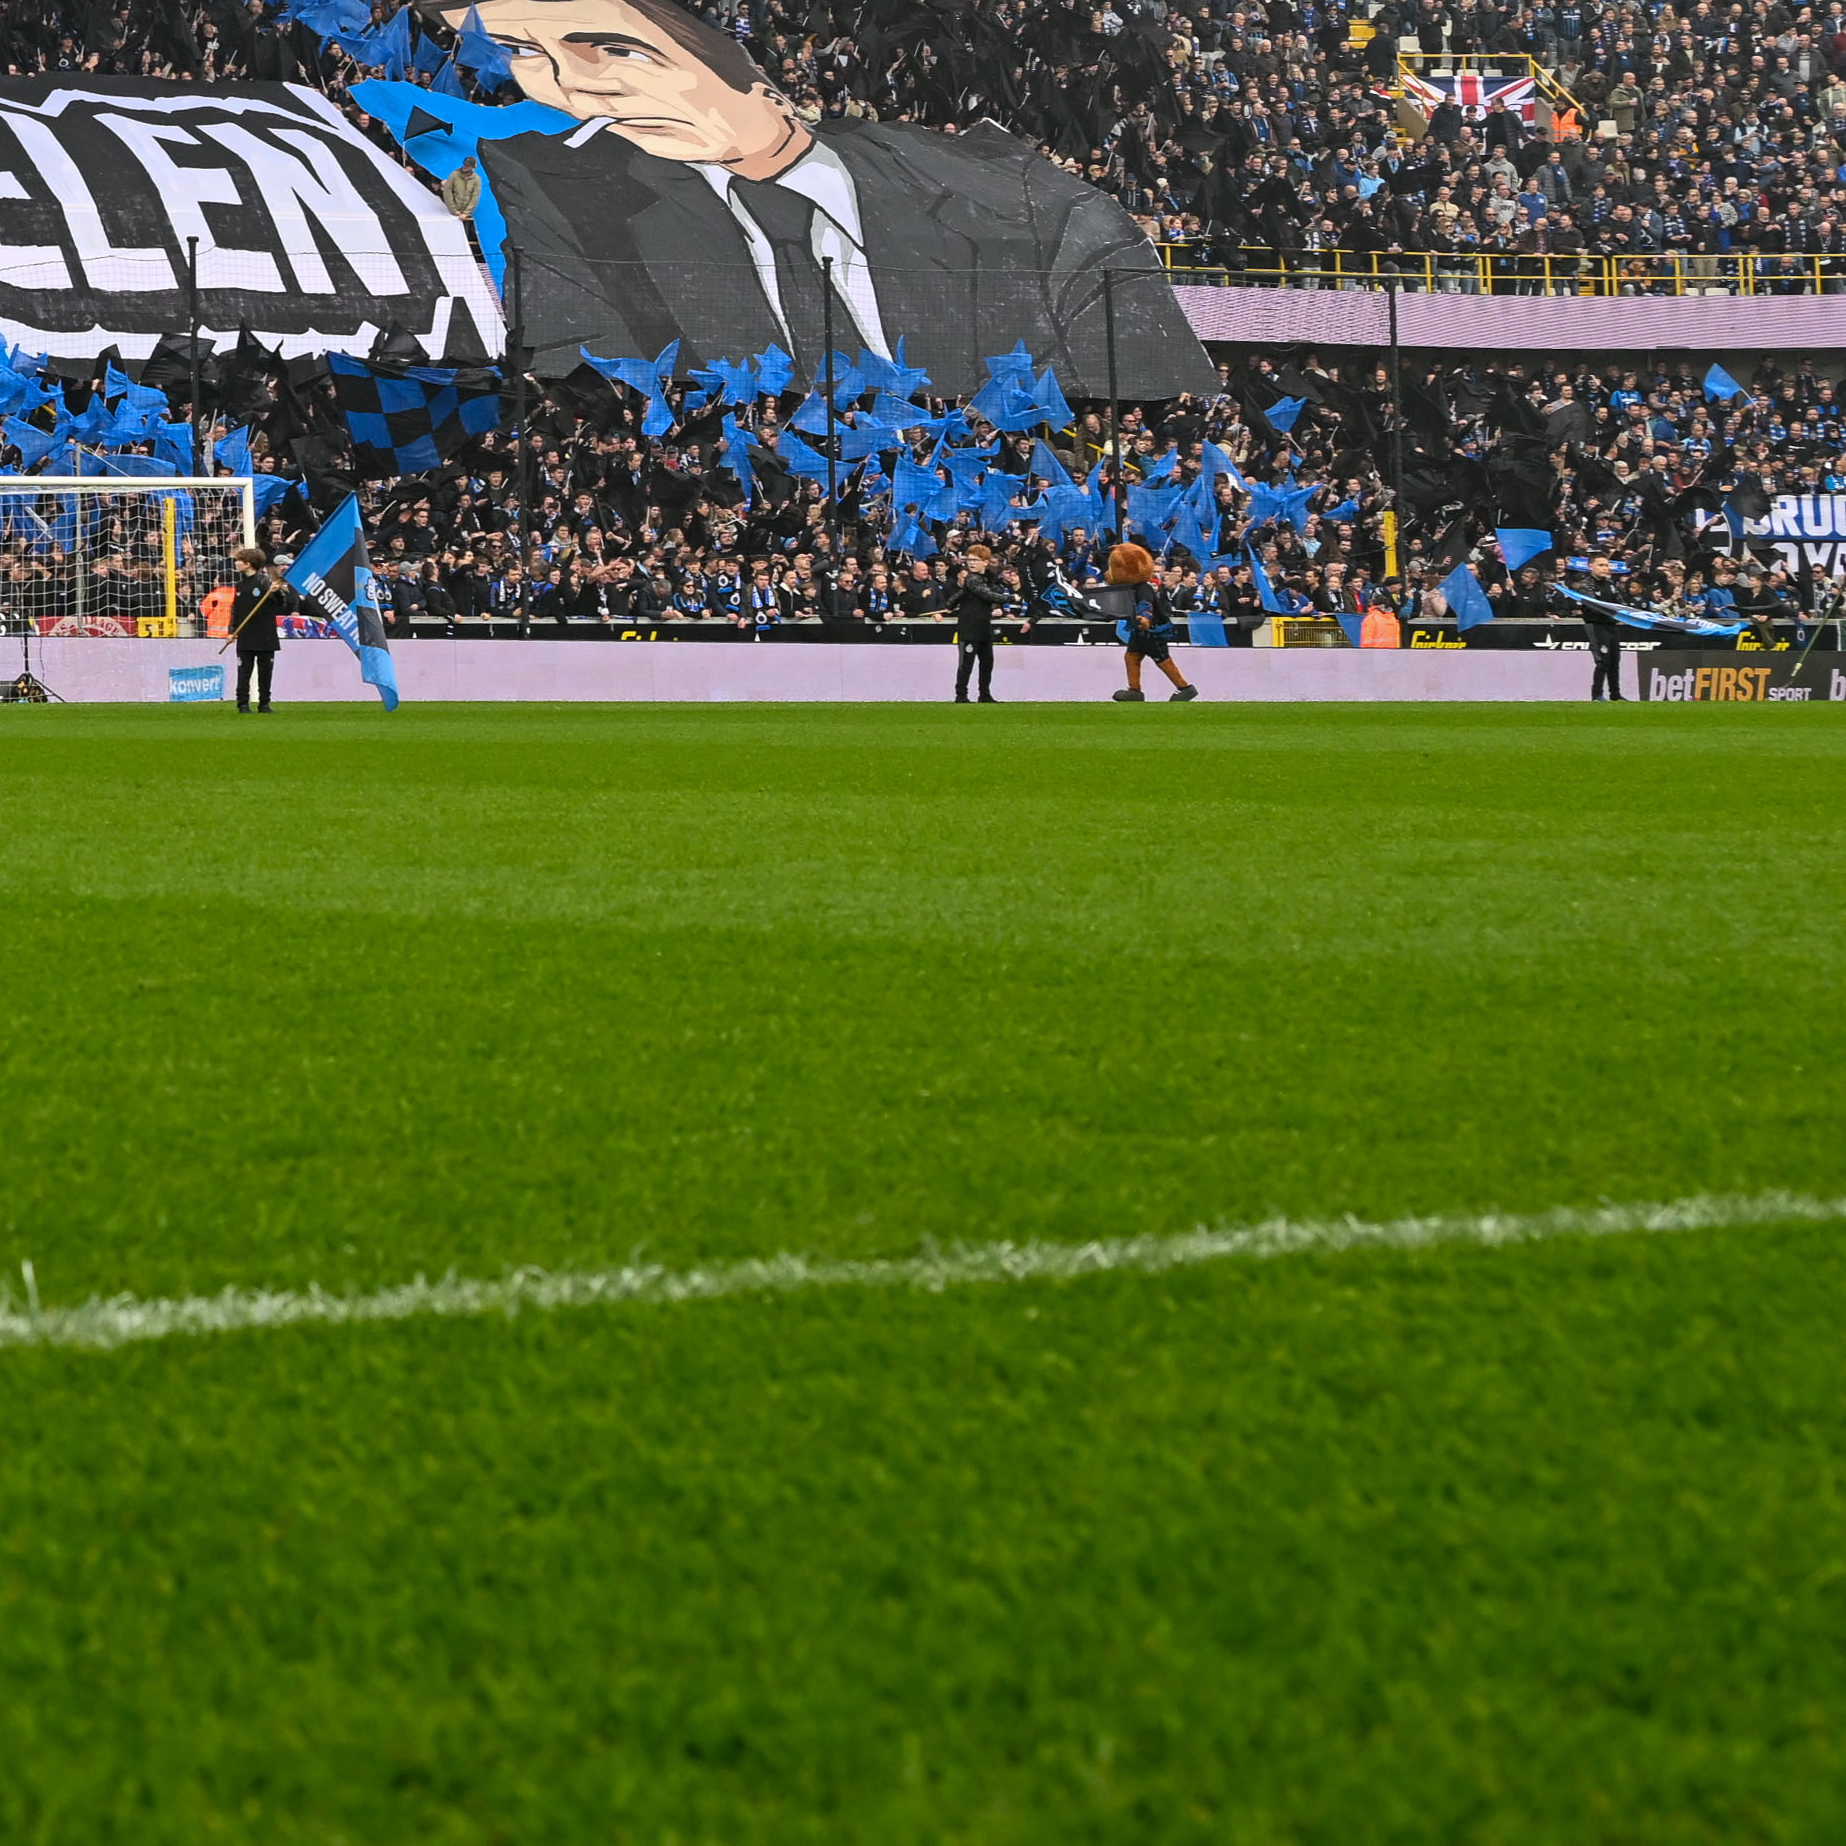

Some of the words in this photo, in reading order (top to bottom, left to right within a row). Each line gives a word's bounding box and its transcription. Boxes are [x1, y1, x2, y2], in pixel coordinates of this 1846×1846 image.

[301, 572, 326, 597] NO
[318, 588, 358, 630] SWEAT
[169, 674, 222, 696] konvert
